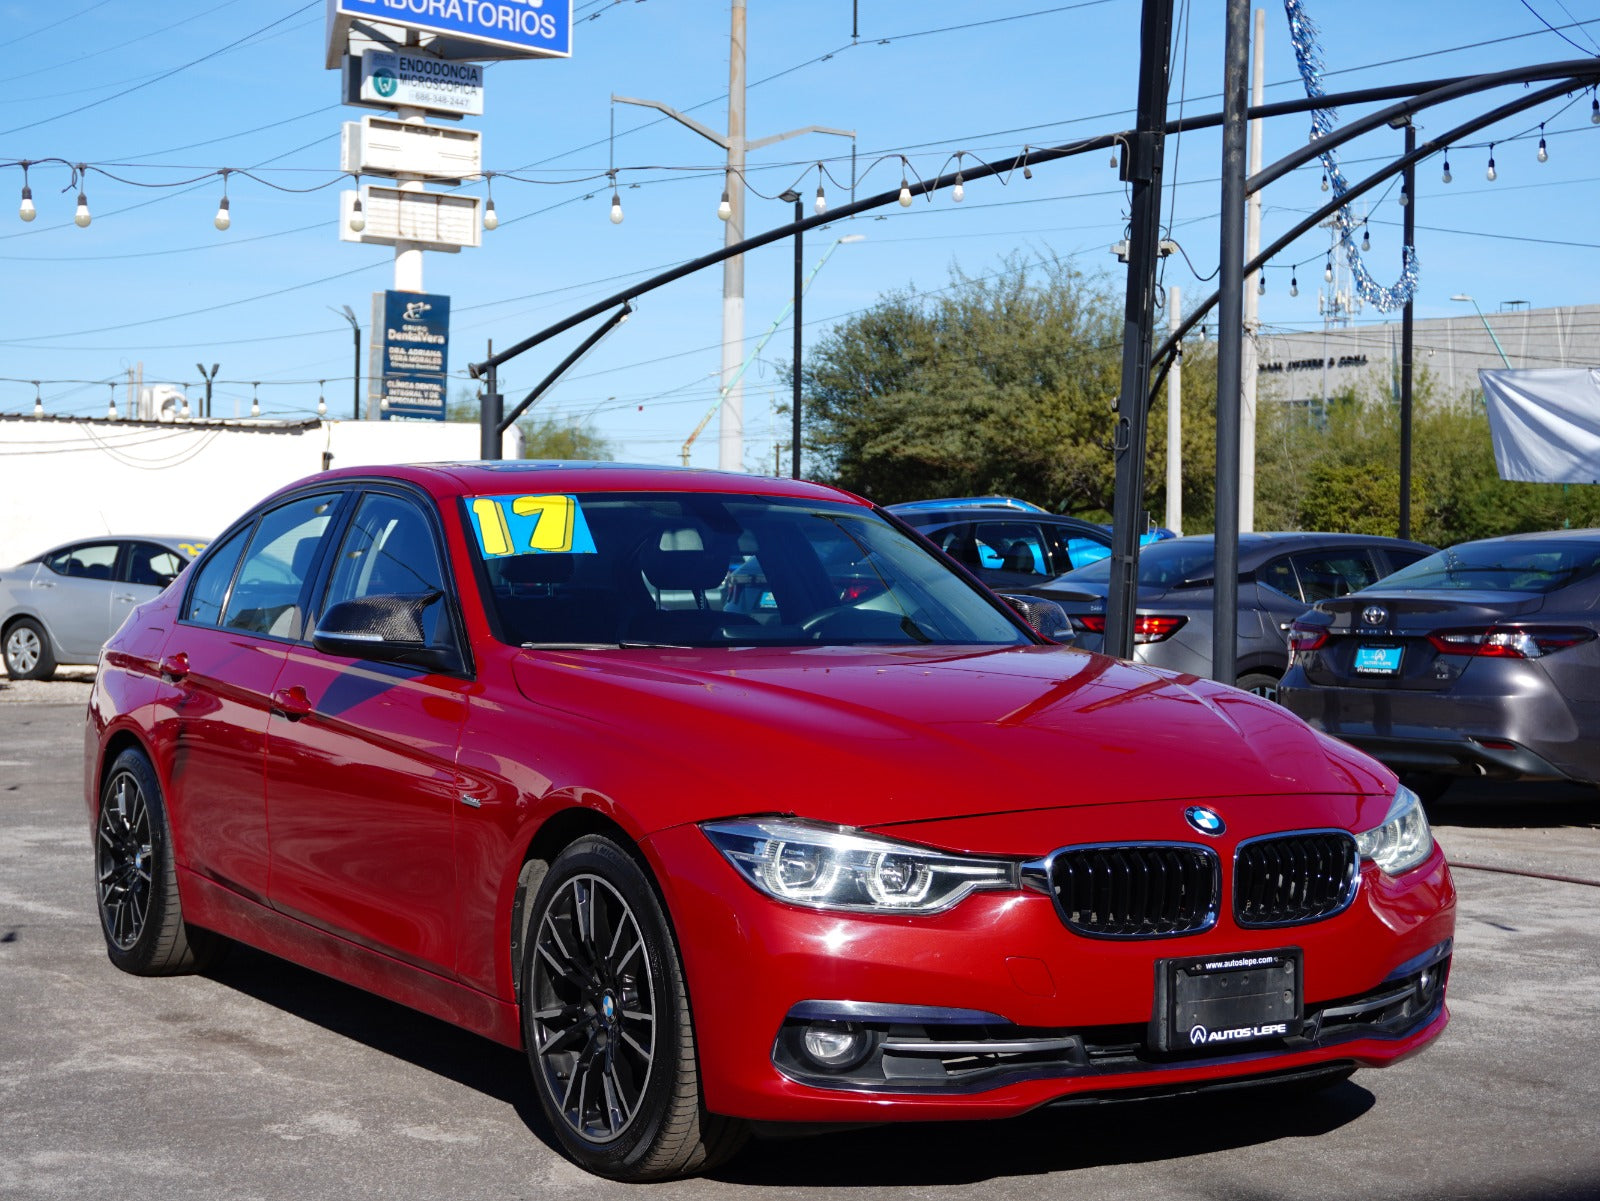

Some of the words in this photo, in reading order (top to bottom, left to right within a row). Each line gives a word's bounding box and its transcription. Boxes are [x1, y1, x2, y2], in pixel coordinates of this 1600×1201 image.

[357, 0, 557, 39] ORATORIOS
[399, 57, 478, 82] ENDODONCIA
[473, 495, 575, 556] 17
[1206, 957, 1272, 969] www.autoslepe.com
